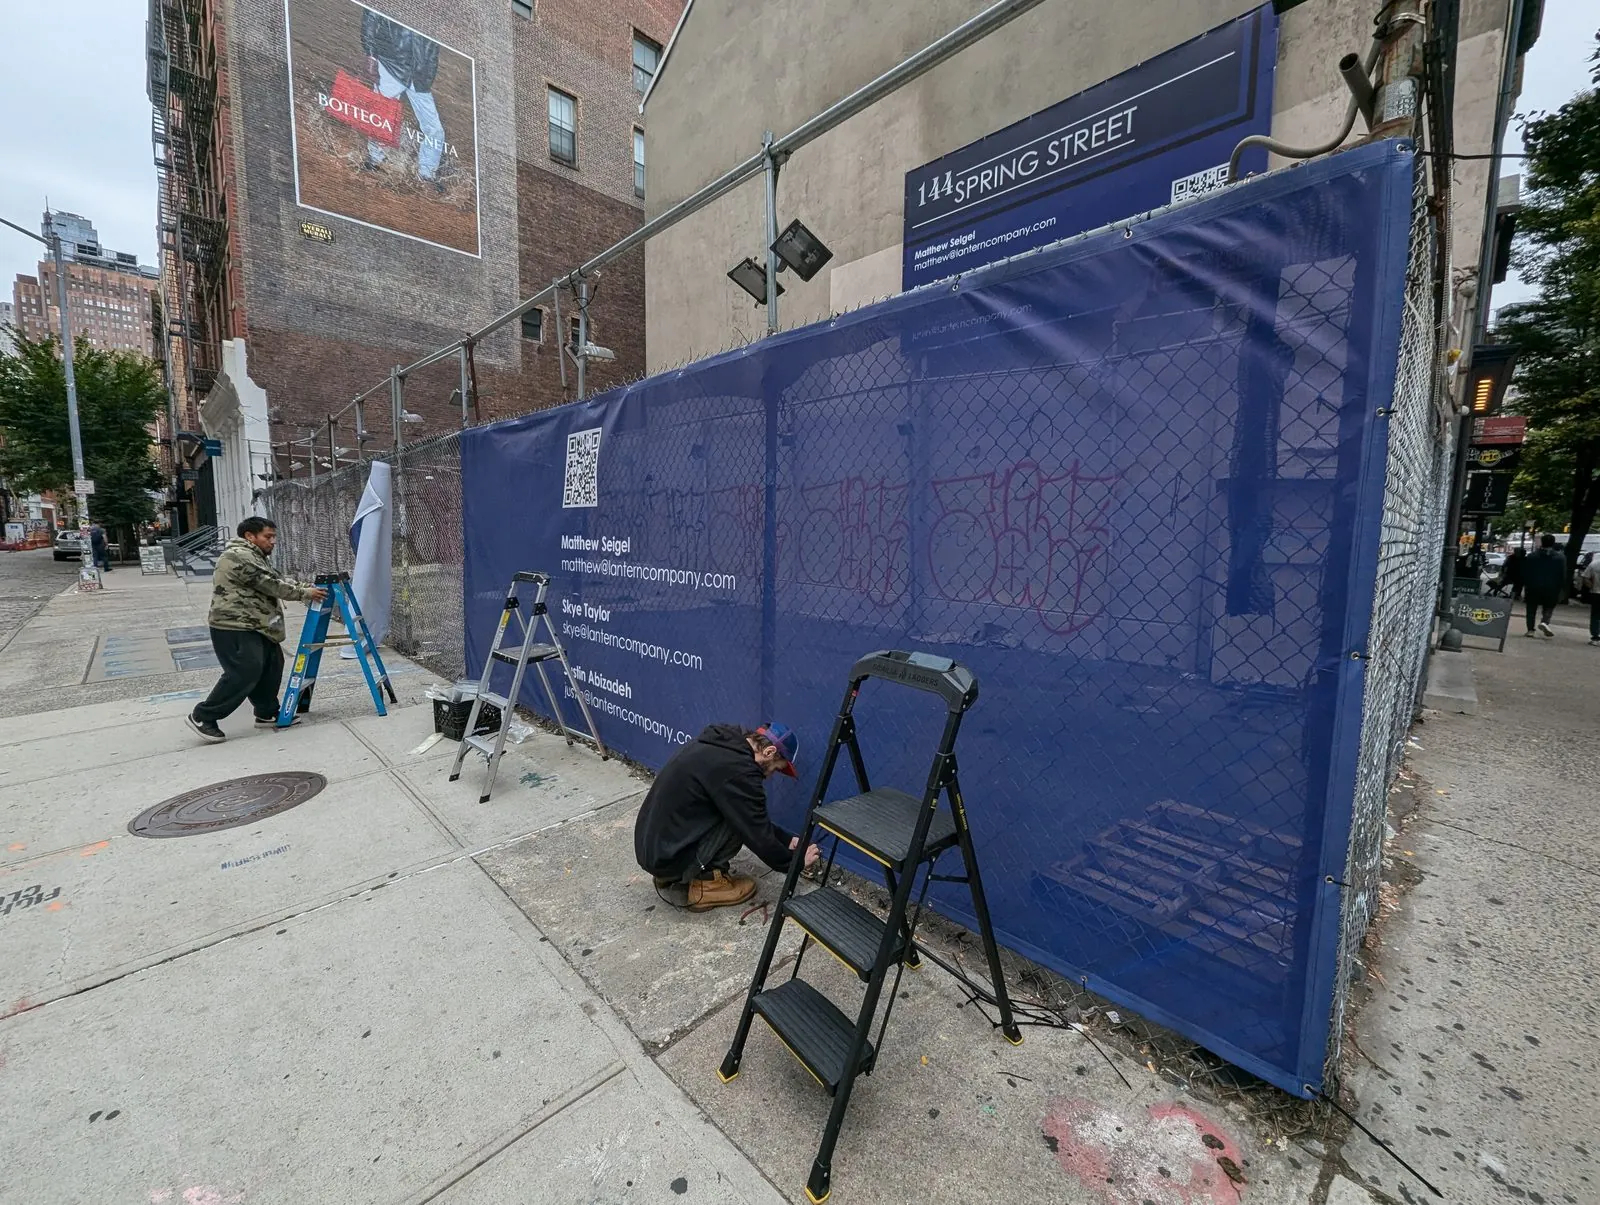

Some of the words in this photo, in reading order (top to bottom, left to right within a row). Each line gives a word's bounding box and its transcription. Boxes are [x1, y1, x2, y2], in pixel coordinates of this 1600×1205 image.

[318, 92, 393, 132] BOTTEGA
[406, 127, 458, 157] VENETA
[918, 171, 953, 207] 144
[954, 150, 1040, 203] SPRING
[1046, 106, 1138, 166] STREET
[914, 215, 1057, 272] matthew@lanterncompany.com
[914, 240, 948, 260] Matthew
[950, 230, 976, 250] Seigel
[561, 534, 599, 551] Matthew
[601, 535, 631, 556] Seigel
[561, 557, 736, 590] matthew@lanterncompany.com
[562, 599, 582, 617] Skye
[584, 602, 611, 623] Taylor
[562, 620, 703, 671] skye@lanterncompany.com
[563, 665, 586, 682] stin
[588, 670, 632, 699] Abizadeh
